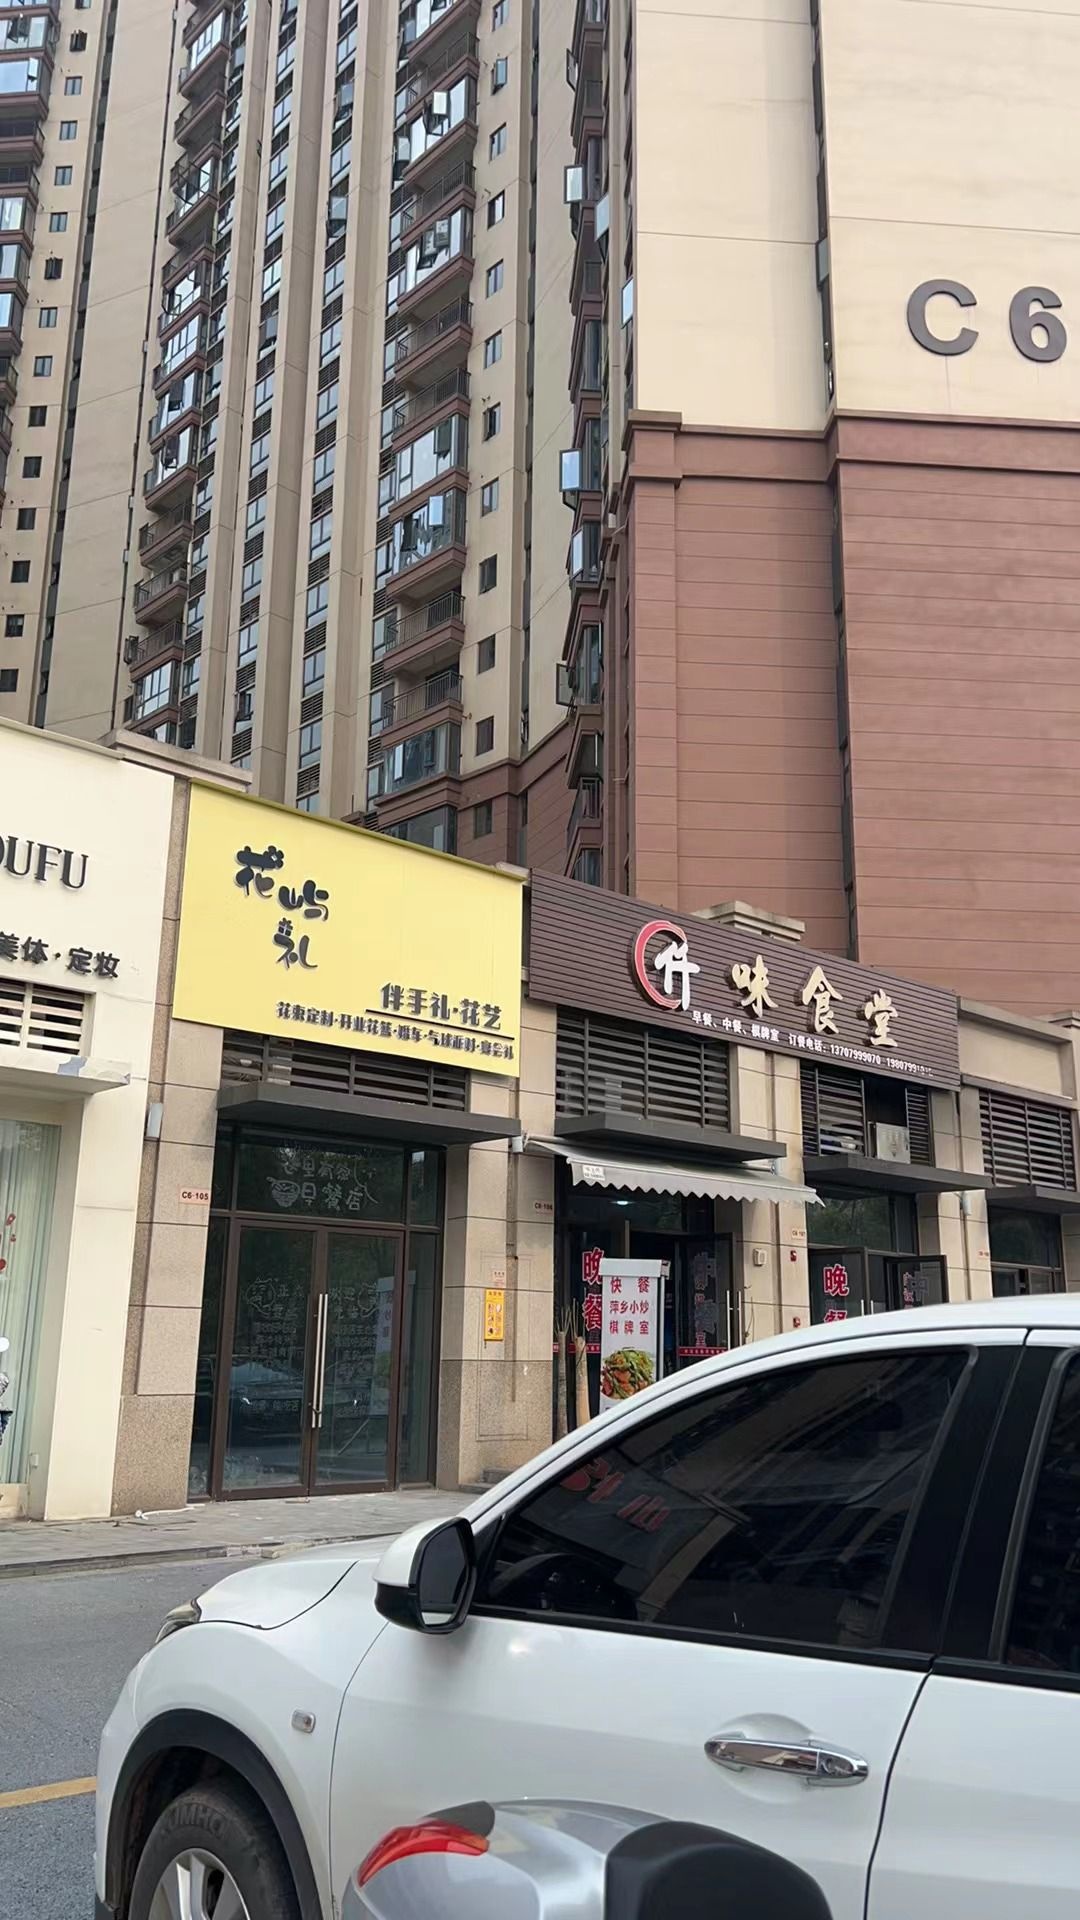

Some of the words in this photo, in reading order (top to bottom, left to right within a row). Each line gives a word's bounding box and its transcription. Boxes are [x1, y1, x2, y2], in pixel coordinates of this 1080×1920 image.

[0, 834, 90, 889] UFU
[609, 1300, 650, 1315] 萍乡小炒
[609, 1320, 650, 1335] 棋牌室
